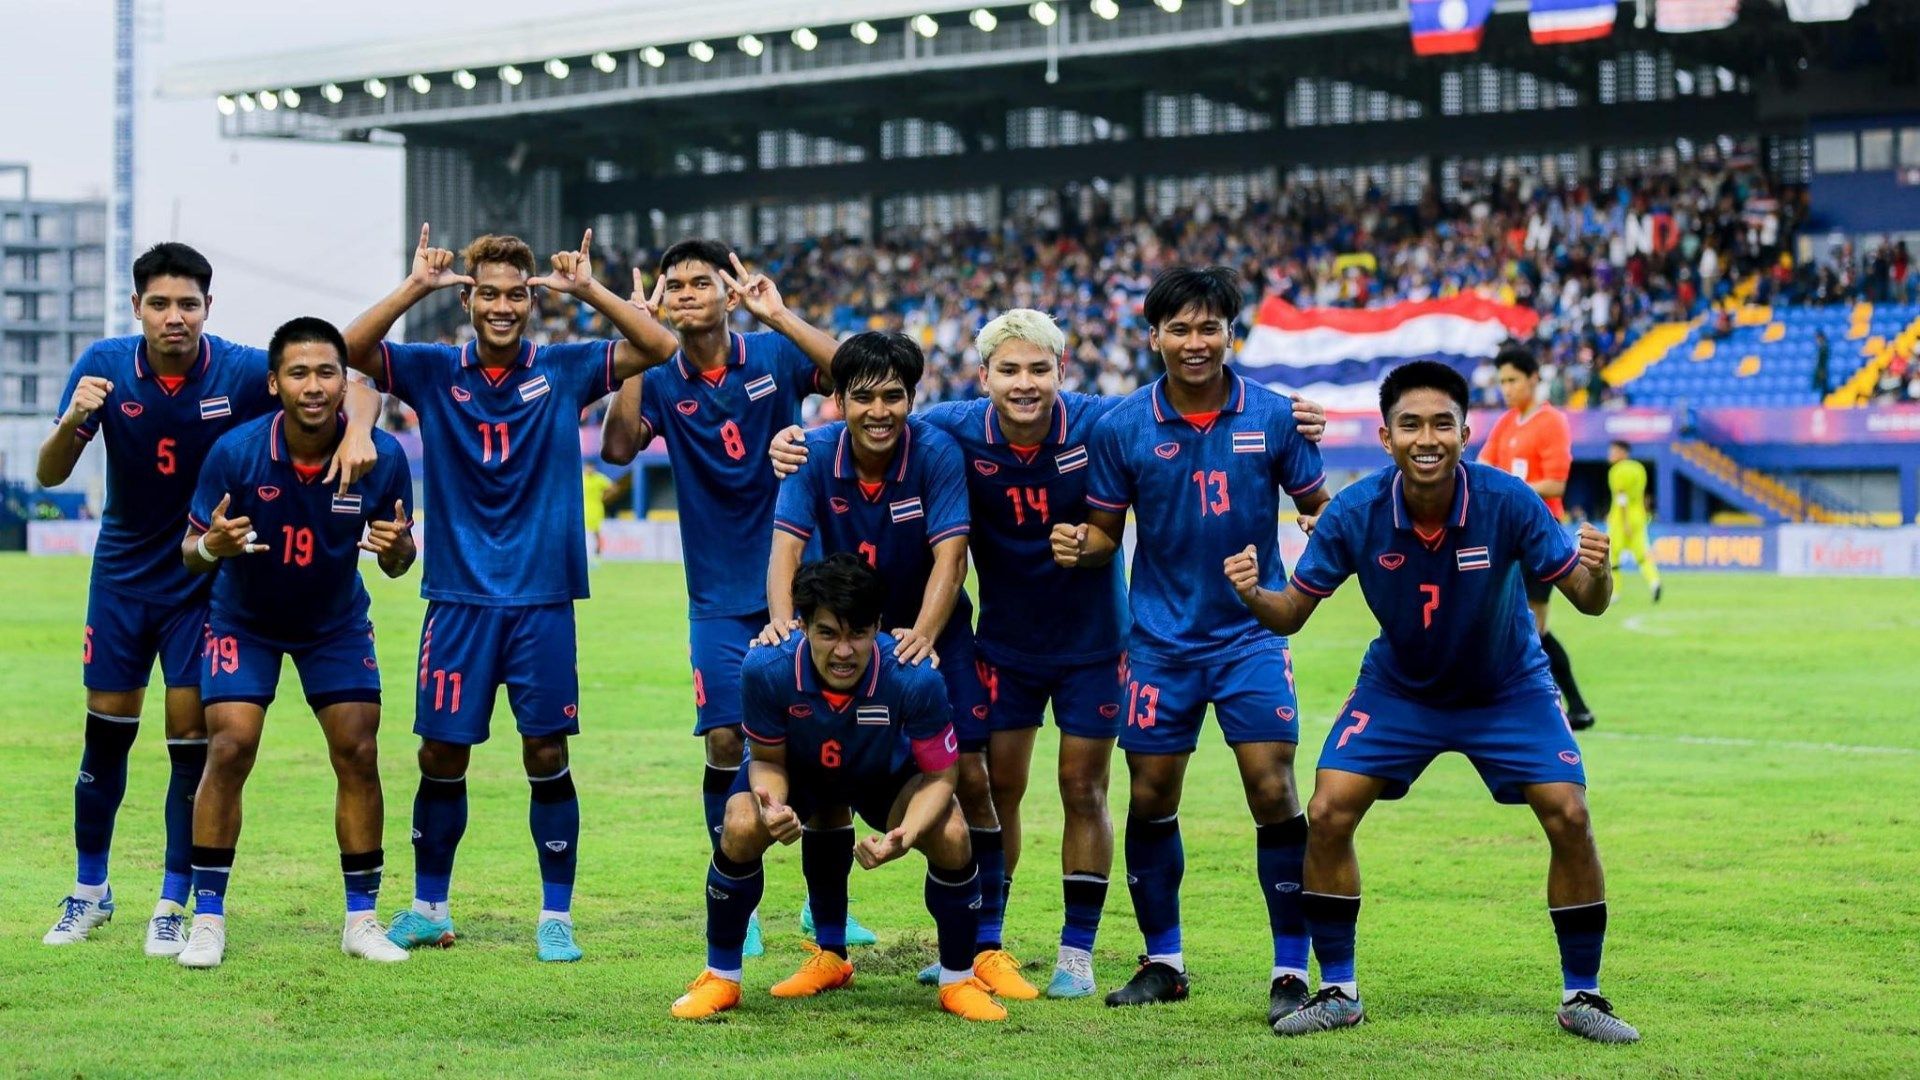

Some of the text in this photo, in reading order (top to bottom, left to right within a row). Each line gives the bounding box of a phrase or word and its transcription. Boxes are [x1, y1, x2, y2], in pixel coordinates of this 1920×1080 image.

[157, 438, 176, 475] 5
[478, 421, 510, 463] 11
[720, 420, 746, 461] 8
[1006, 486, 1049, 525] 14
[1192, 469, 1231, 517] 13
[282, 524, 314, 567] 19
[1419, 583, 1441, 629] 7
[207, 635, 239, 677] 19
[433, 669, 462, 713] 11
[693, 667, 707, 708] 8
[1127, 681, 1160, 729] 13
[1337, 710, 1371, 749] 7
[821, 738, 841, 768] 6
